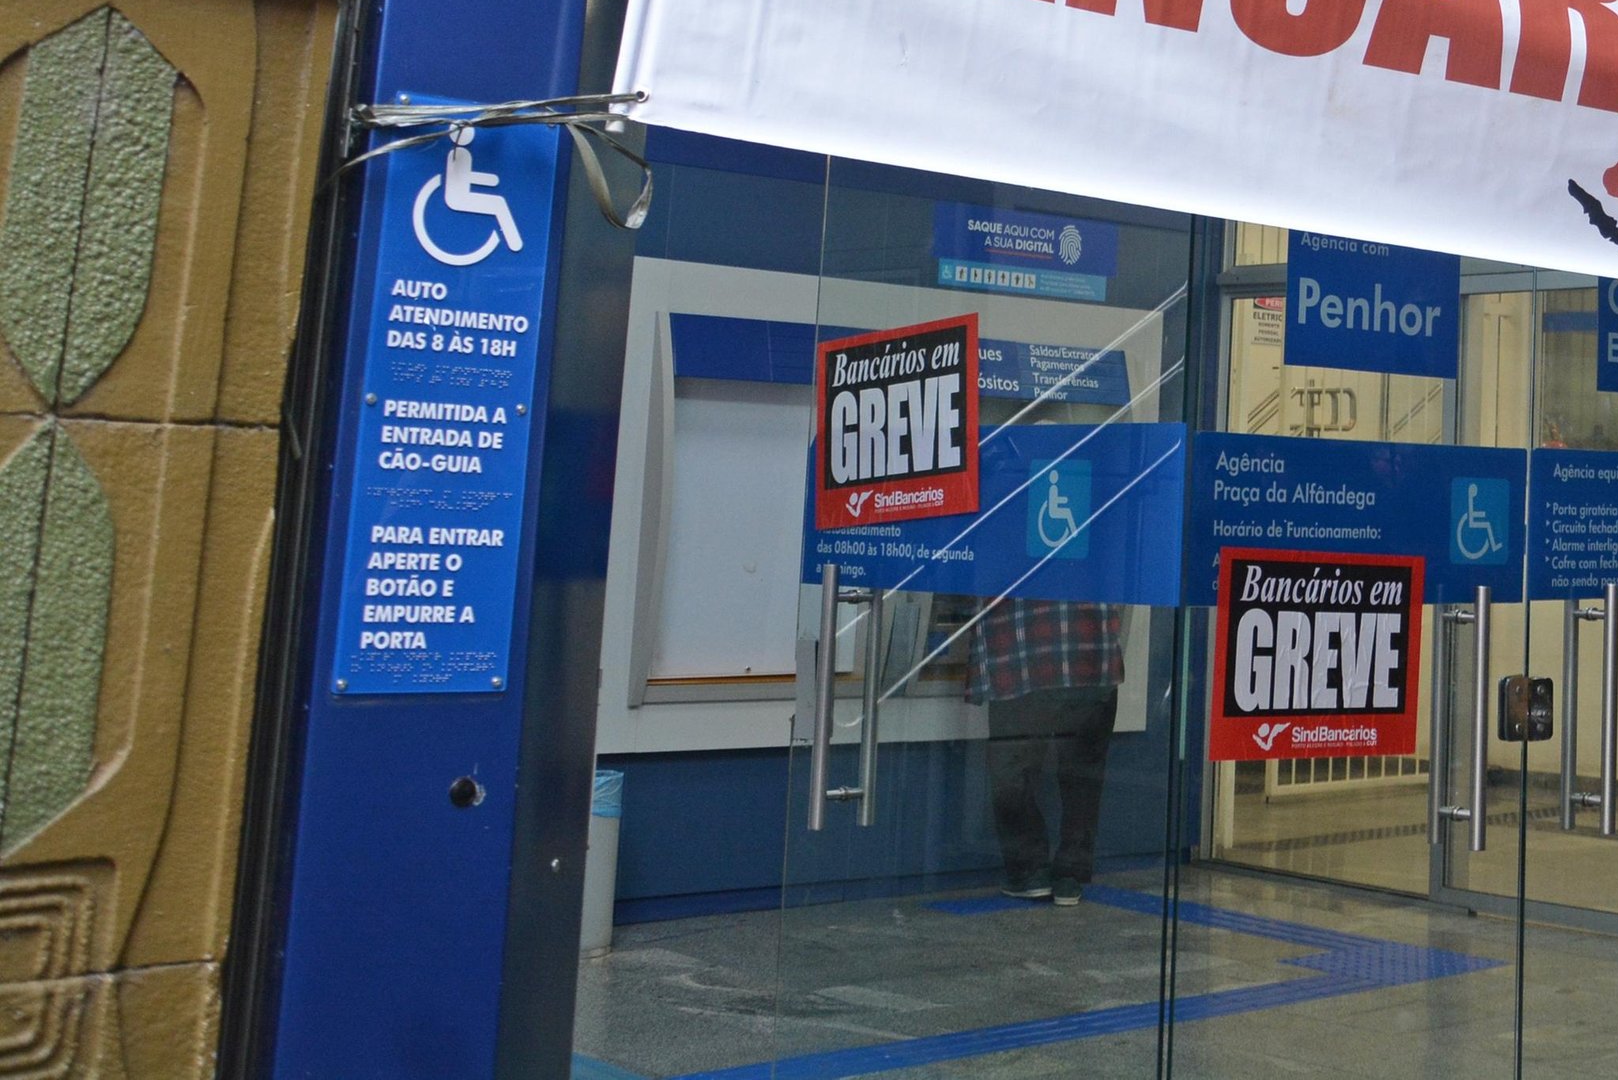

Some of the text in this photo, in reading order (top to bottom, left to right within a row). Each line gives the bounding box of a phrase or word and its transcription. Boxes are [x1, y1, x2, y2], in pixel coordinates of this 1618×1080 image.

[967, 219, 1055, 240] SAQUE AQUI COM
[984, 236, 1054, 254] A SUA DIGITAL
[1362, 242, 1389, 257] com
[392, 279, 447, 300] AUTO
[1297, 277, 1441, 337] Penhor
[389, 305, 529, 333] ATENDIMENTO
[387, 330, 516, 357] DAS 8 ÀS 18H
[832, 341, 960, 387] Bancários em
[384, 400, 507, 424] PERMITIDA A
[381, 426, 504, 449] ENTRADA DE
[831, 373, 960, 484] GREVE
[378, 448, 482, 473] CÃO-GUIA
[1216, 451, 1285, 476] Agência
[1553, 463, 1595, 482] Agência
[874, 486, 944, 508] SindBancários
[1214, 480, 1375, 509] Praça da Alfândega
[1552, 502, 1577, 516] Porta
[1580, 503, 1618, 519] giratória
[371, 525, 504, 547] PARA ENTRAR
[1213, 520, 1381, 540] Horário de Funcionamento:
[1552, 520, 1586, 534] Circuito
[817, 539, 975, 563] das 08h00 às 18h00, de segunda
[1552, 537, 1585, 551] Alarme
[368, 552, 463, 572] APERTE O
[816, 563, 822, 573] a
[1551, 555, 1576, 569] Cofre
[1578, 559, 1597, 569] com
[366, 575, 454, 598] BOTÃO E
[1240, 565, 1403, 606] Bancários em
[1551, 574, 1569, 587] não
[1571, 572, 1598, 587] sendo
[363, 605, 475, 623] EMPURRE A
[360, 631, 427, 650] PORTA
[1233, 608, 1401, 712] GREVE
[1291, 725, 1377, 743] SindBancários
